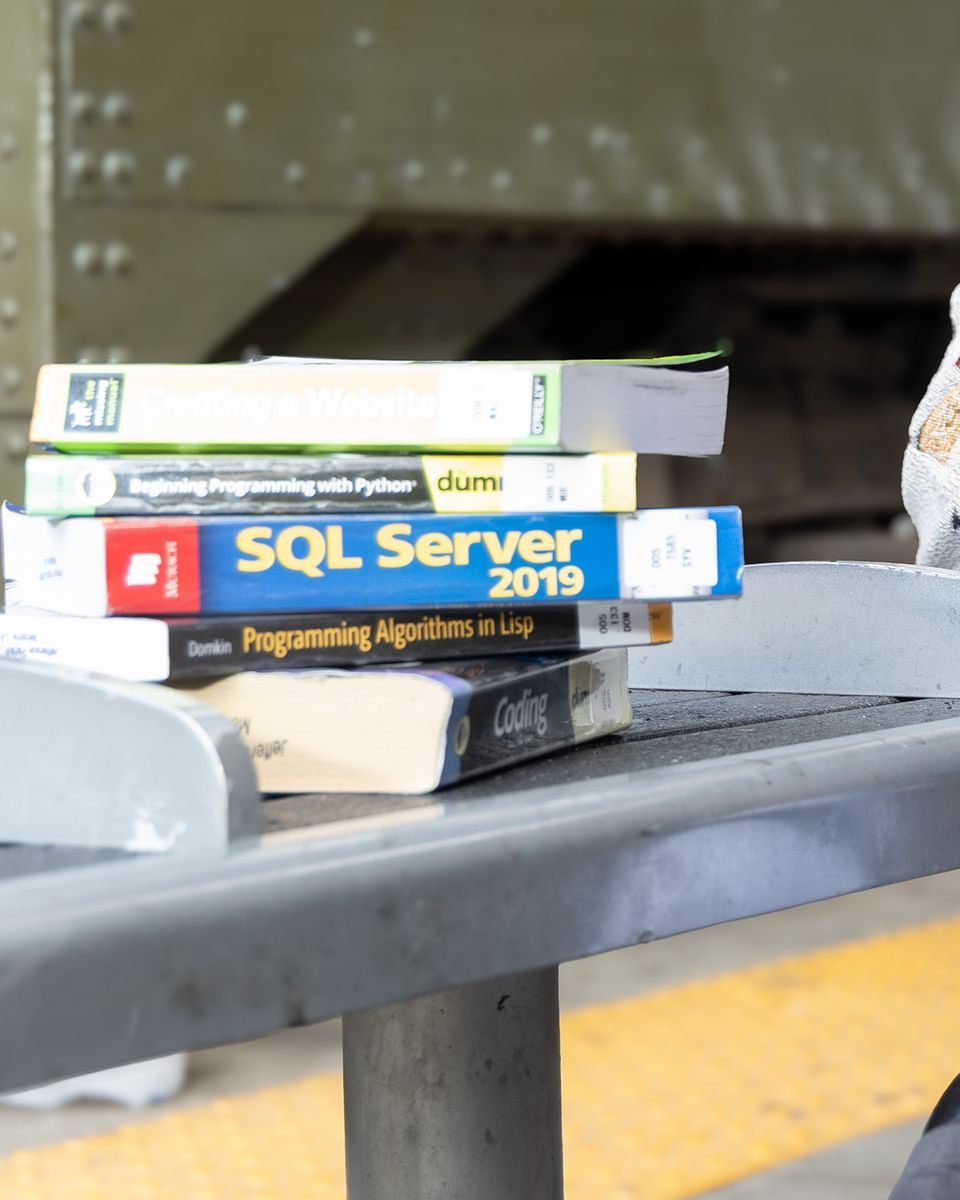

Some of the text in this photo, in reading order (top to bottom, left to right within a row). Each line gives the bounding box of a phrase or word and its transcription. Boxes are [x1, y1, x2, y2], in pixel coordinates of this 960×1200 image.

[304, 386, 438, 419] Website
[129, 477, 207, 498] Beginning
[209, 477, 315, 498] Programming
[318, 476, 353, 494] with
[236, 523, 583, 578] SQL Server
[488, 565, 585, 599] 2019
[242, 611, 534, 659] Programming Algorithms in Lisp
[599, 614, 608, 634] 005
[622, 612, 632, 632] DOM
[187, 638, 232, 658] Domkin
[494, 688, 549, 736] Coding
